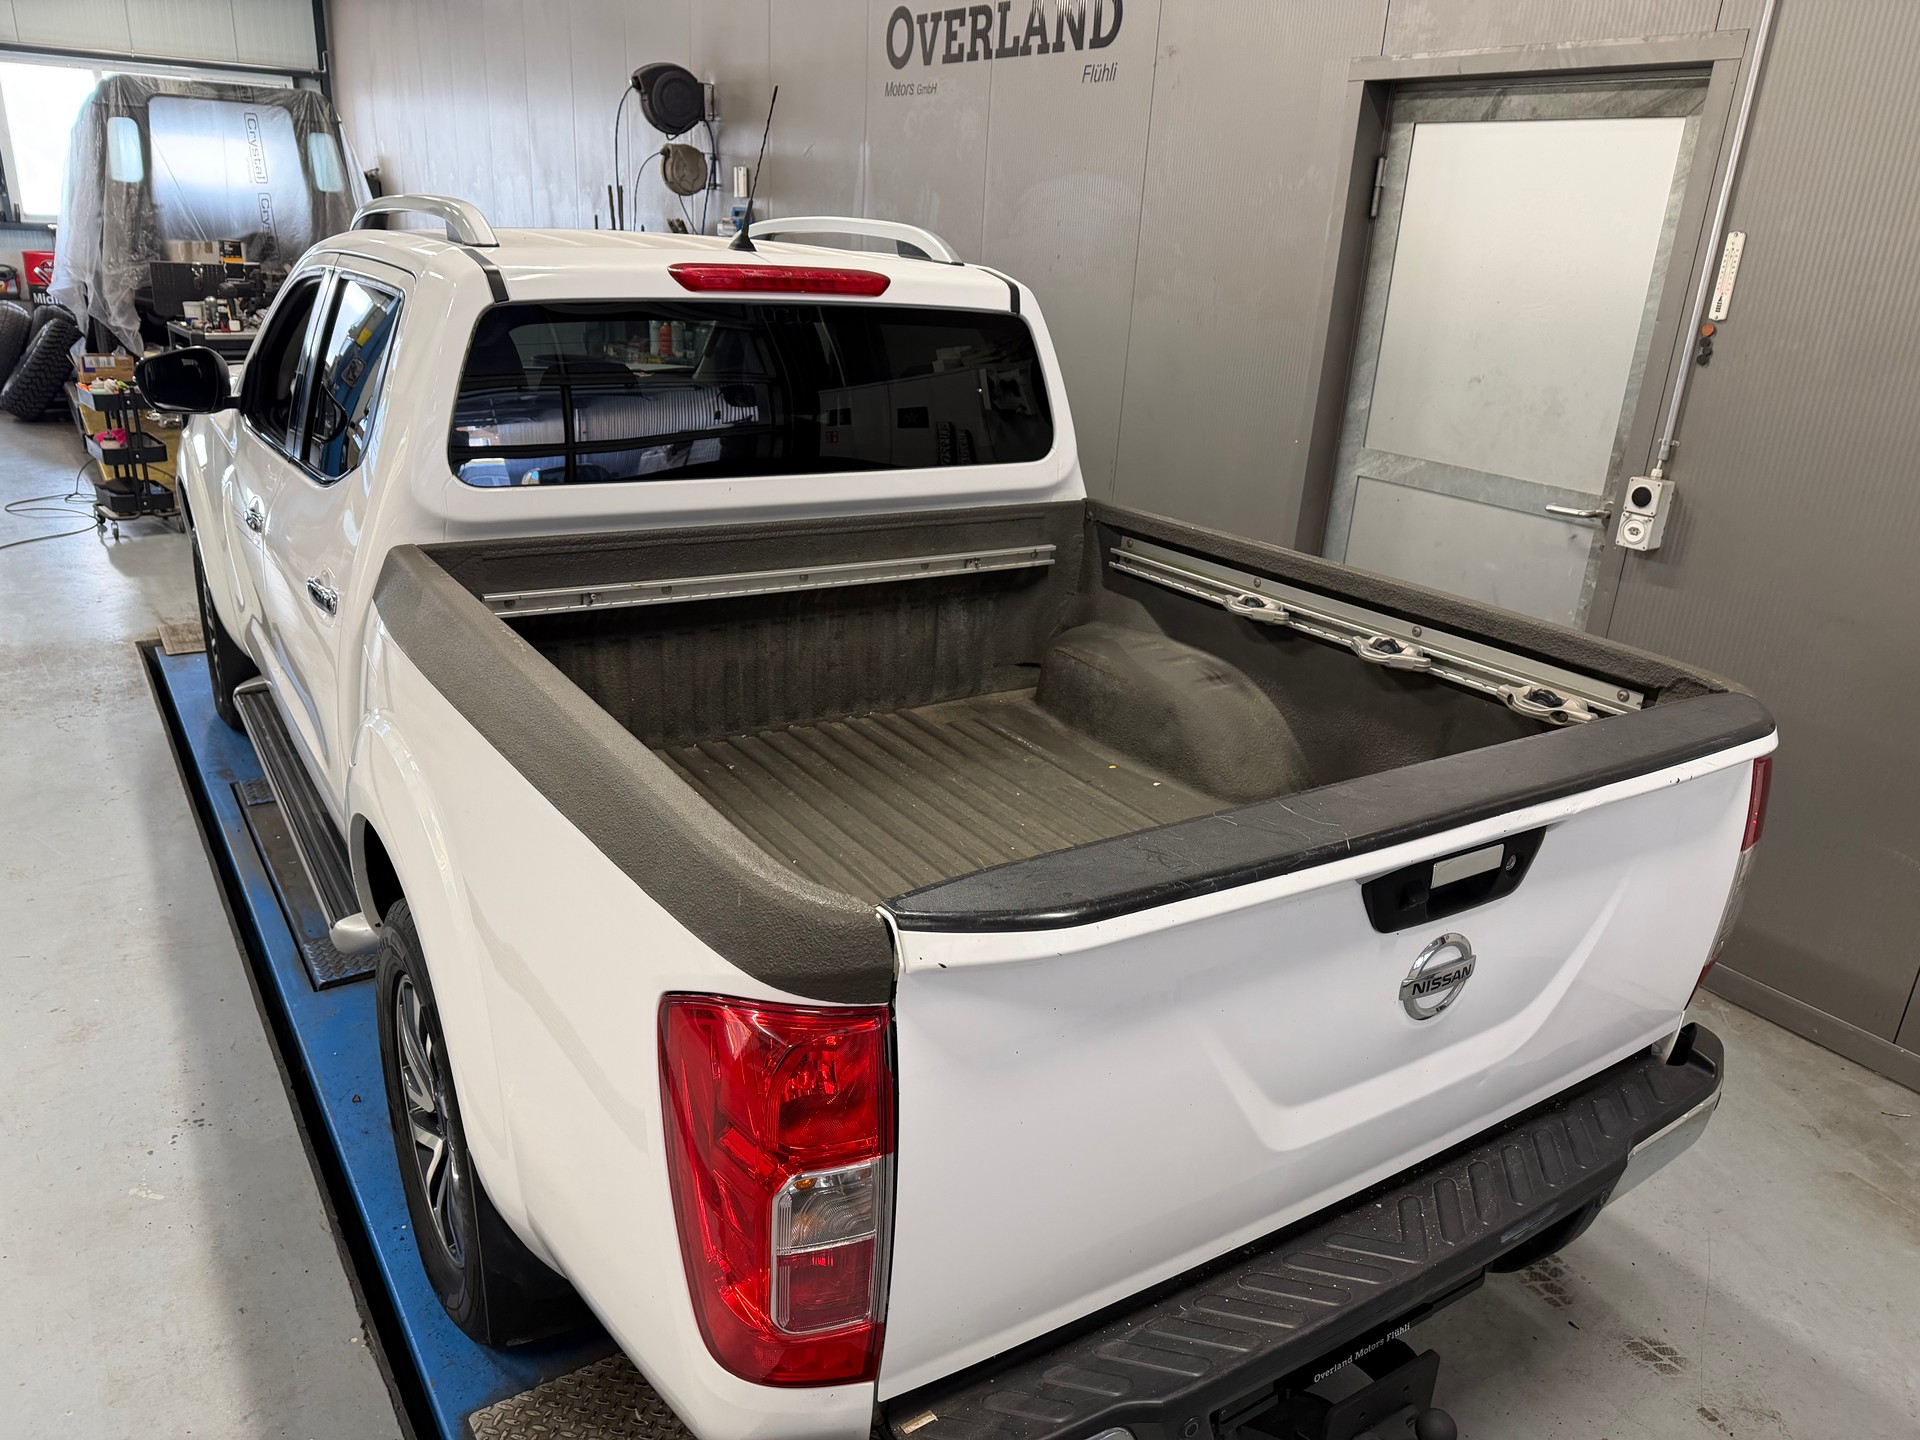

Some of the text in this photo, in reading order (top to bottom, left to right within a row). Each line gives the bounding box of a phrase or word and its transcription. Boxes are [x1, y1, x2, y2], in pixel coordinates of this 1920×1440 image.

[886, 0, 1124, 70] OVERLAND
[884, 81, 938, 97] Motors GmbH
[1081, 62, 1118, 84] Flühli
[246, 117, 266, 180] Crystal
[1411, 963, 1472, 996] NISSAN
[1313, 1322, 1411, 1383] Overland Motors Flühli
